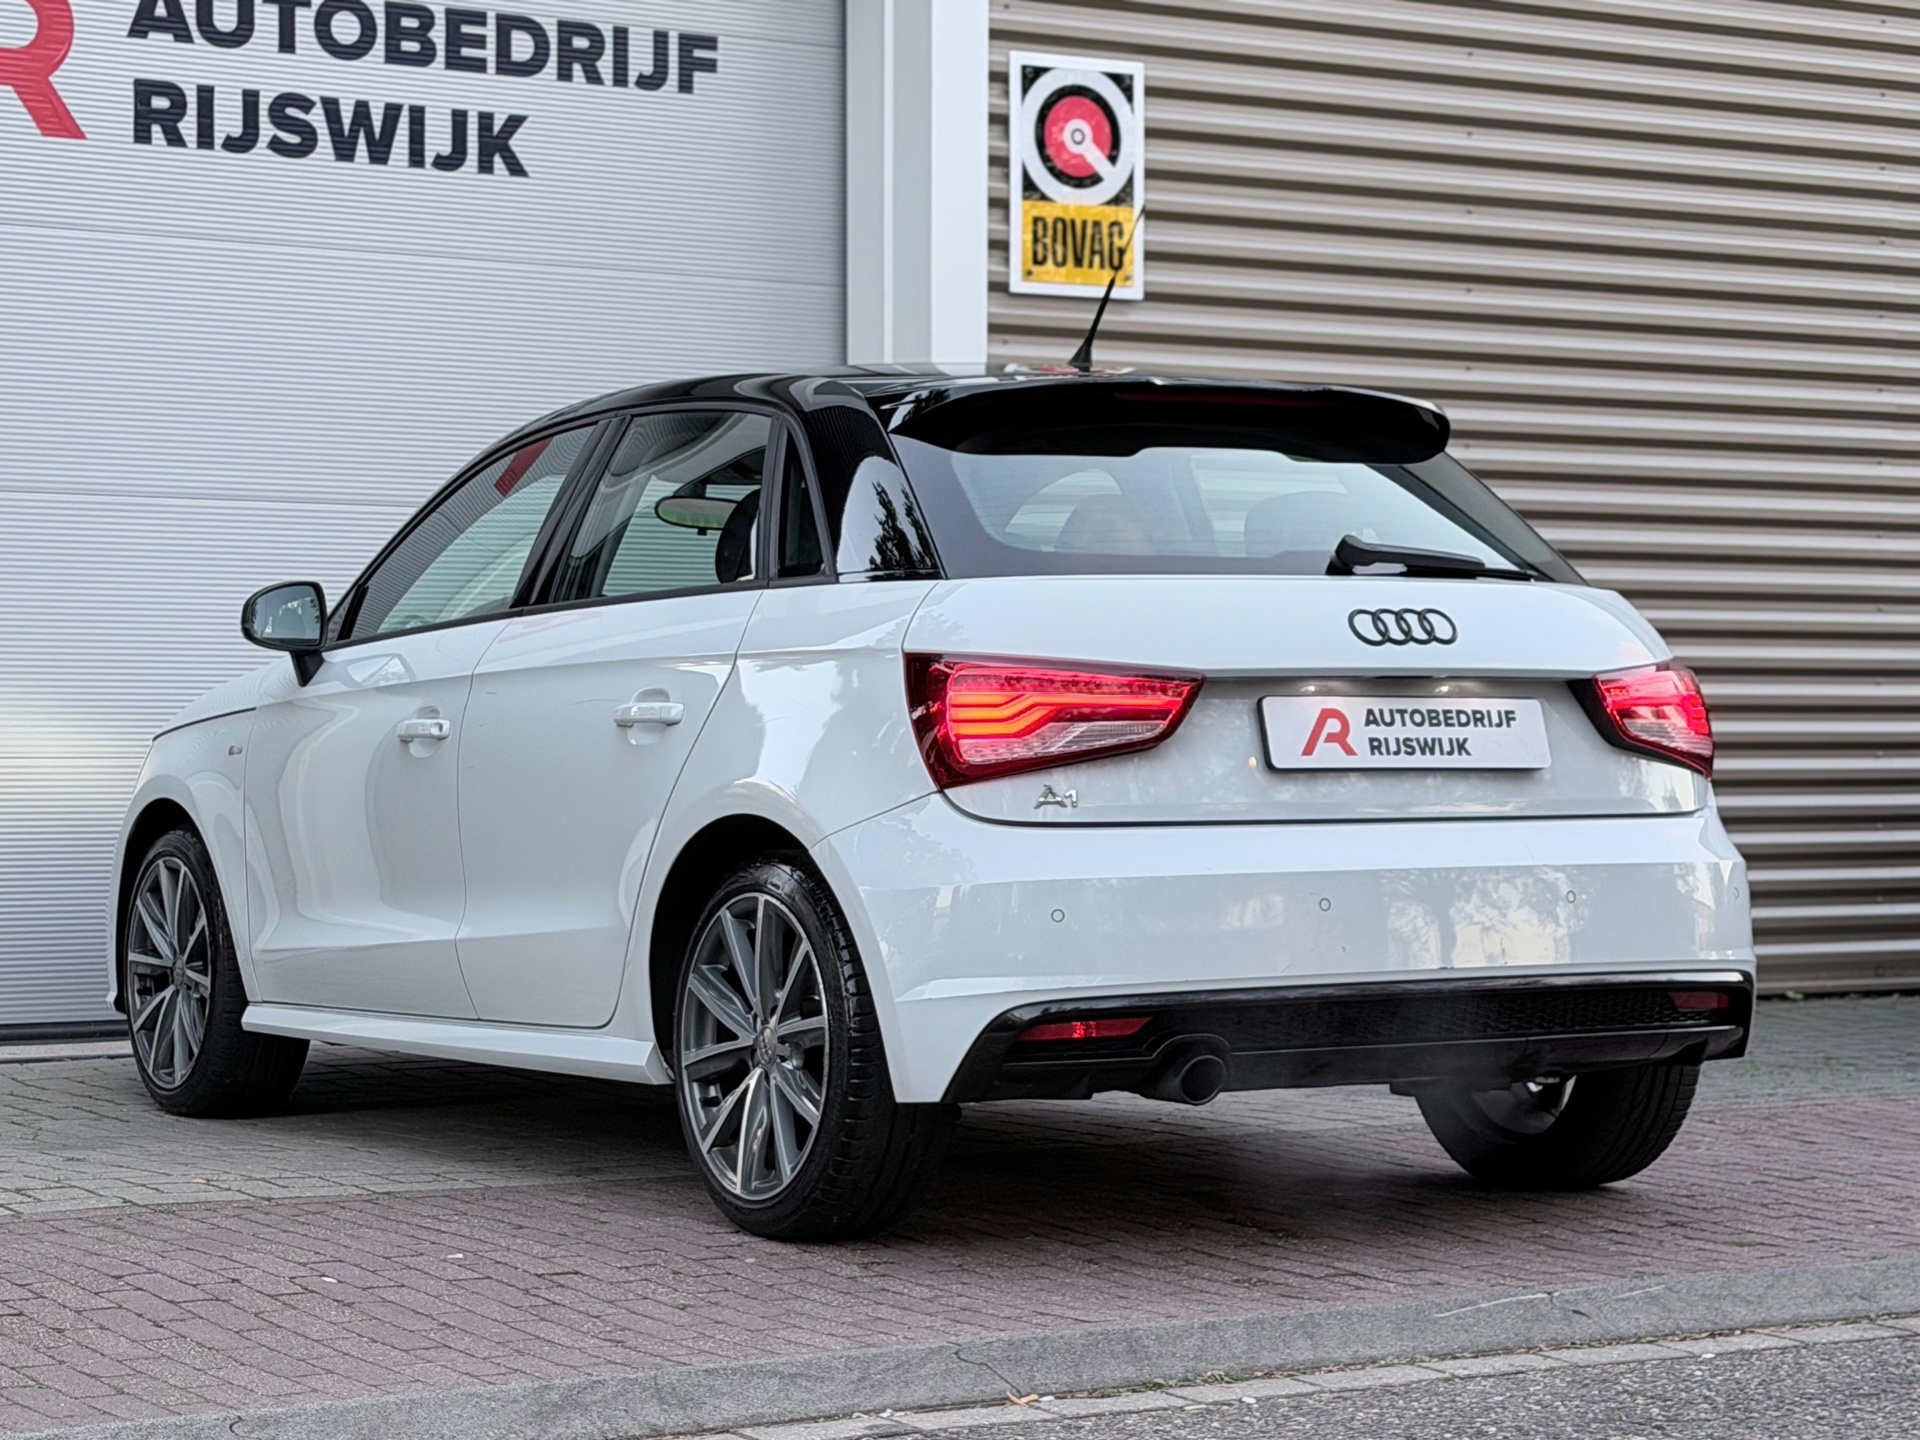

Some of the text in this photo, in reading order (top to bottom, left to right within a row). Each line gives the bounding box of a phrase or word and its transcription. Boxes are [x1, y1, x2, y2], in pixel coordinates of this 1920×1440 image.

[128, 0, 719, 95] AUTOBEDRIJF
[131, 78, 530, 178] RIJSWIJK
[1033, 216, 1124, 271] BOVAG
[1364, 708, 1517, 728] AUTOBEDRIJF
[1368, 736, 1472, 757] RIJSWIJK
[1033, 783, 1078, 809] A1
